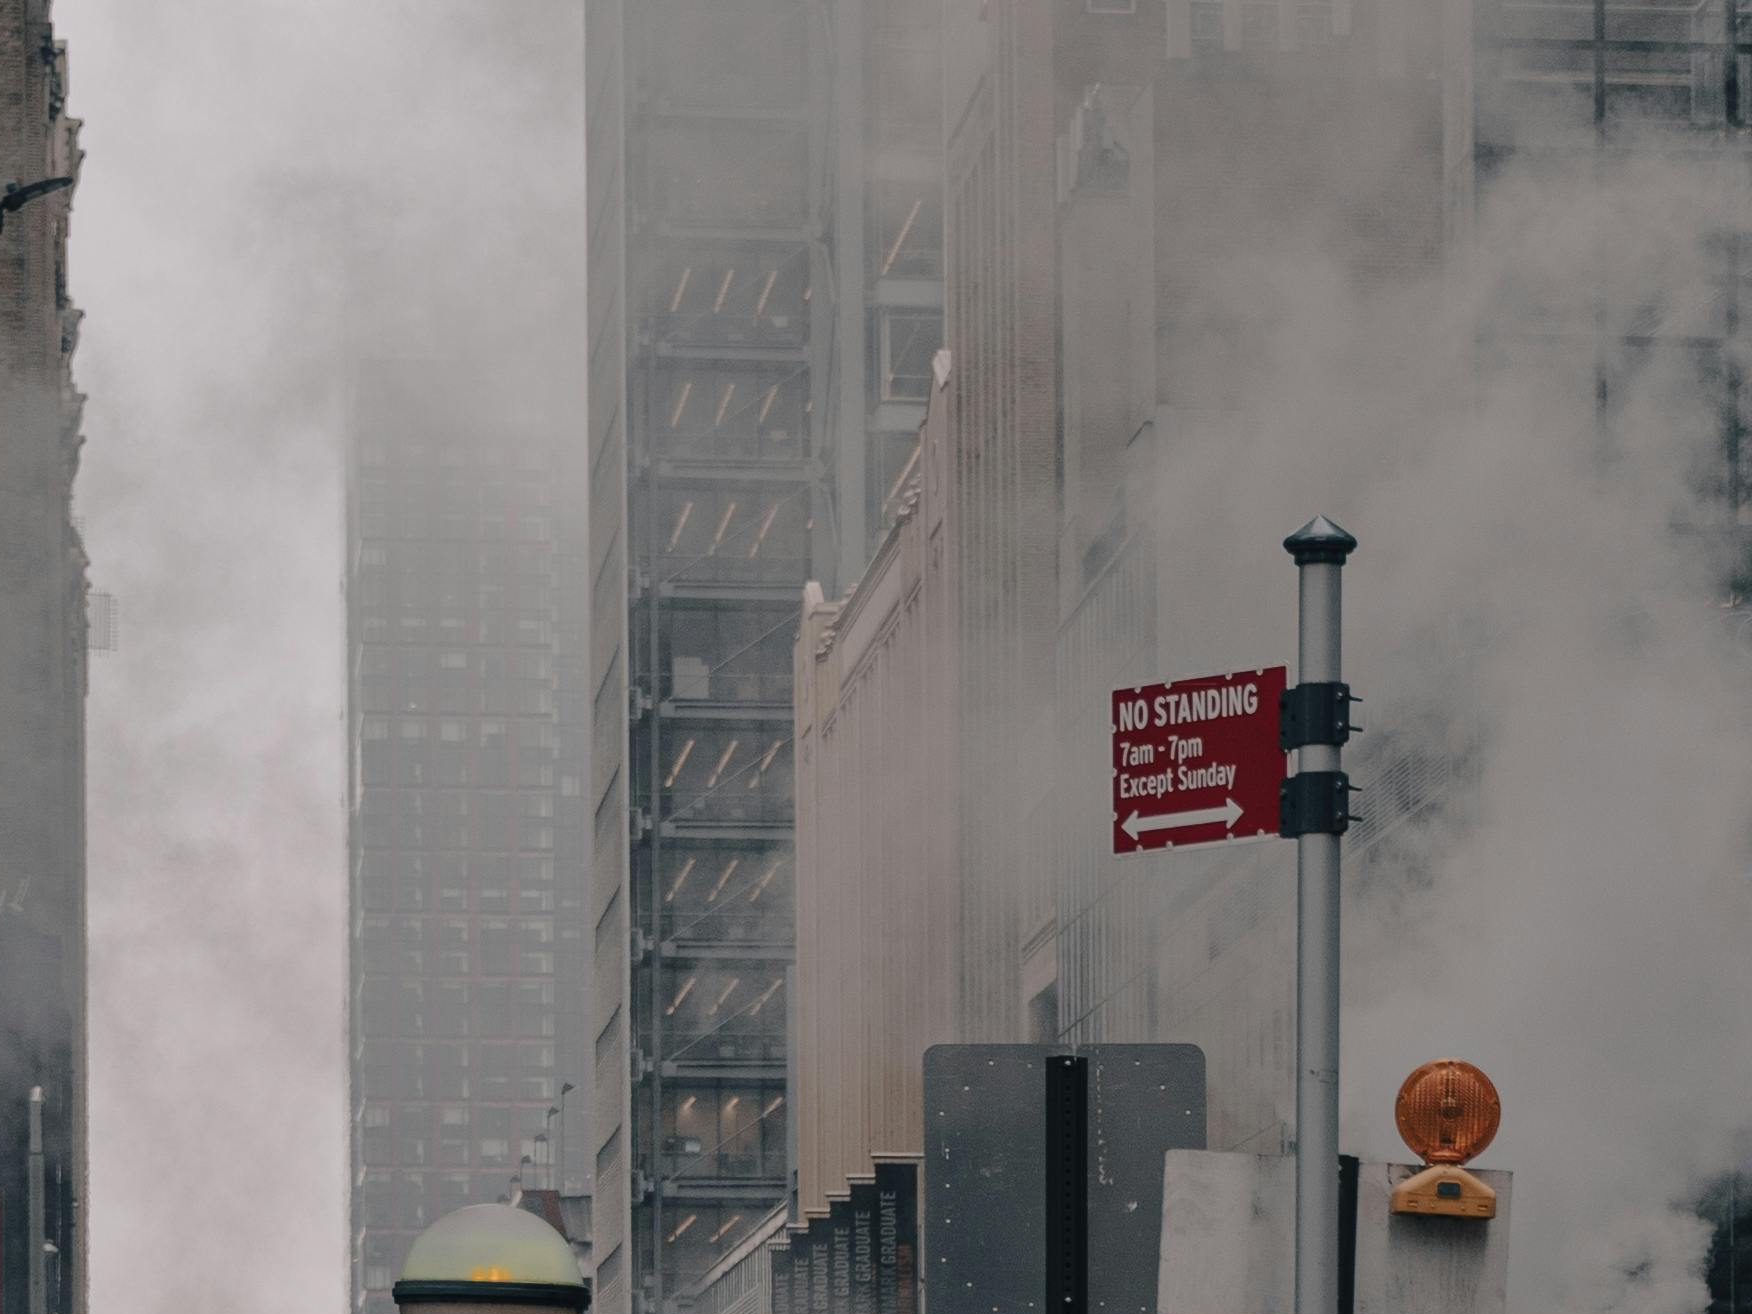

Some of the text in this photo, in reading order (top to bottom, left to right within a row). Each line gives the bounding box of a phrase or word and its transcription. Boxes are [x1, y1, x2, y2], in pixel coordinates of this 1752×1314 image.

[1119, 683, 1258, 732] NO STANDING
[1120, 741, 1154, 767] 7am
[1168, 735, 1203, 764] 7pm
[1120, 761, 1236, 799] Except Sunday
[880, 1191, 897, 1264] GRADUATE
